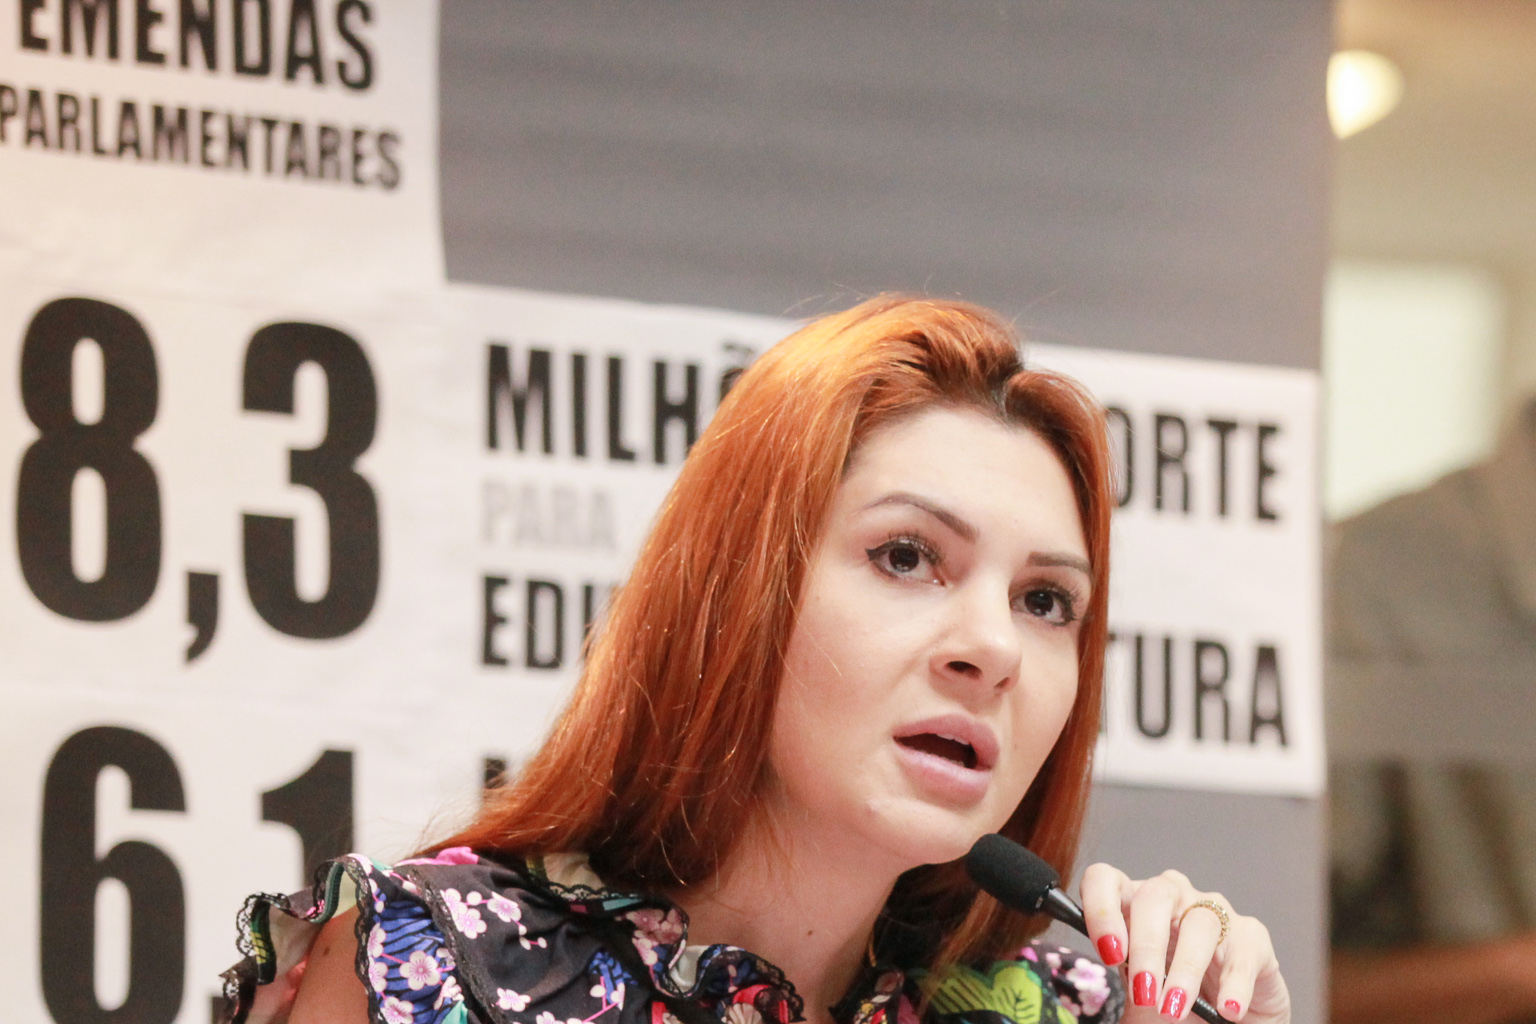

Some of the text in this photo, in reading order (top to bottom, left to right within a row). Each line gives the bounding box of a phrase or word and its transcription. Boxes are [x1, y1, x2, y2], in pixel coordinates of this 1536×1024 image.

[20, 0, 374, 91] EMENDAS
[0, 84, 402, 191] PARLAMENTARES
[17, 297, 382, 664] 8,3
[1106, 406, 1279, 522] ORTE
